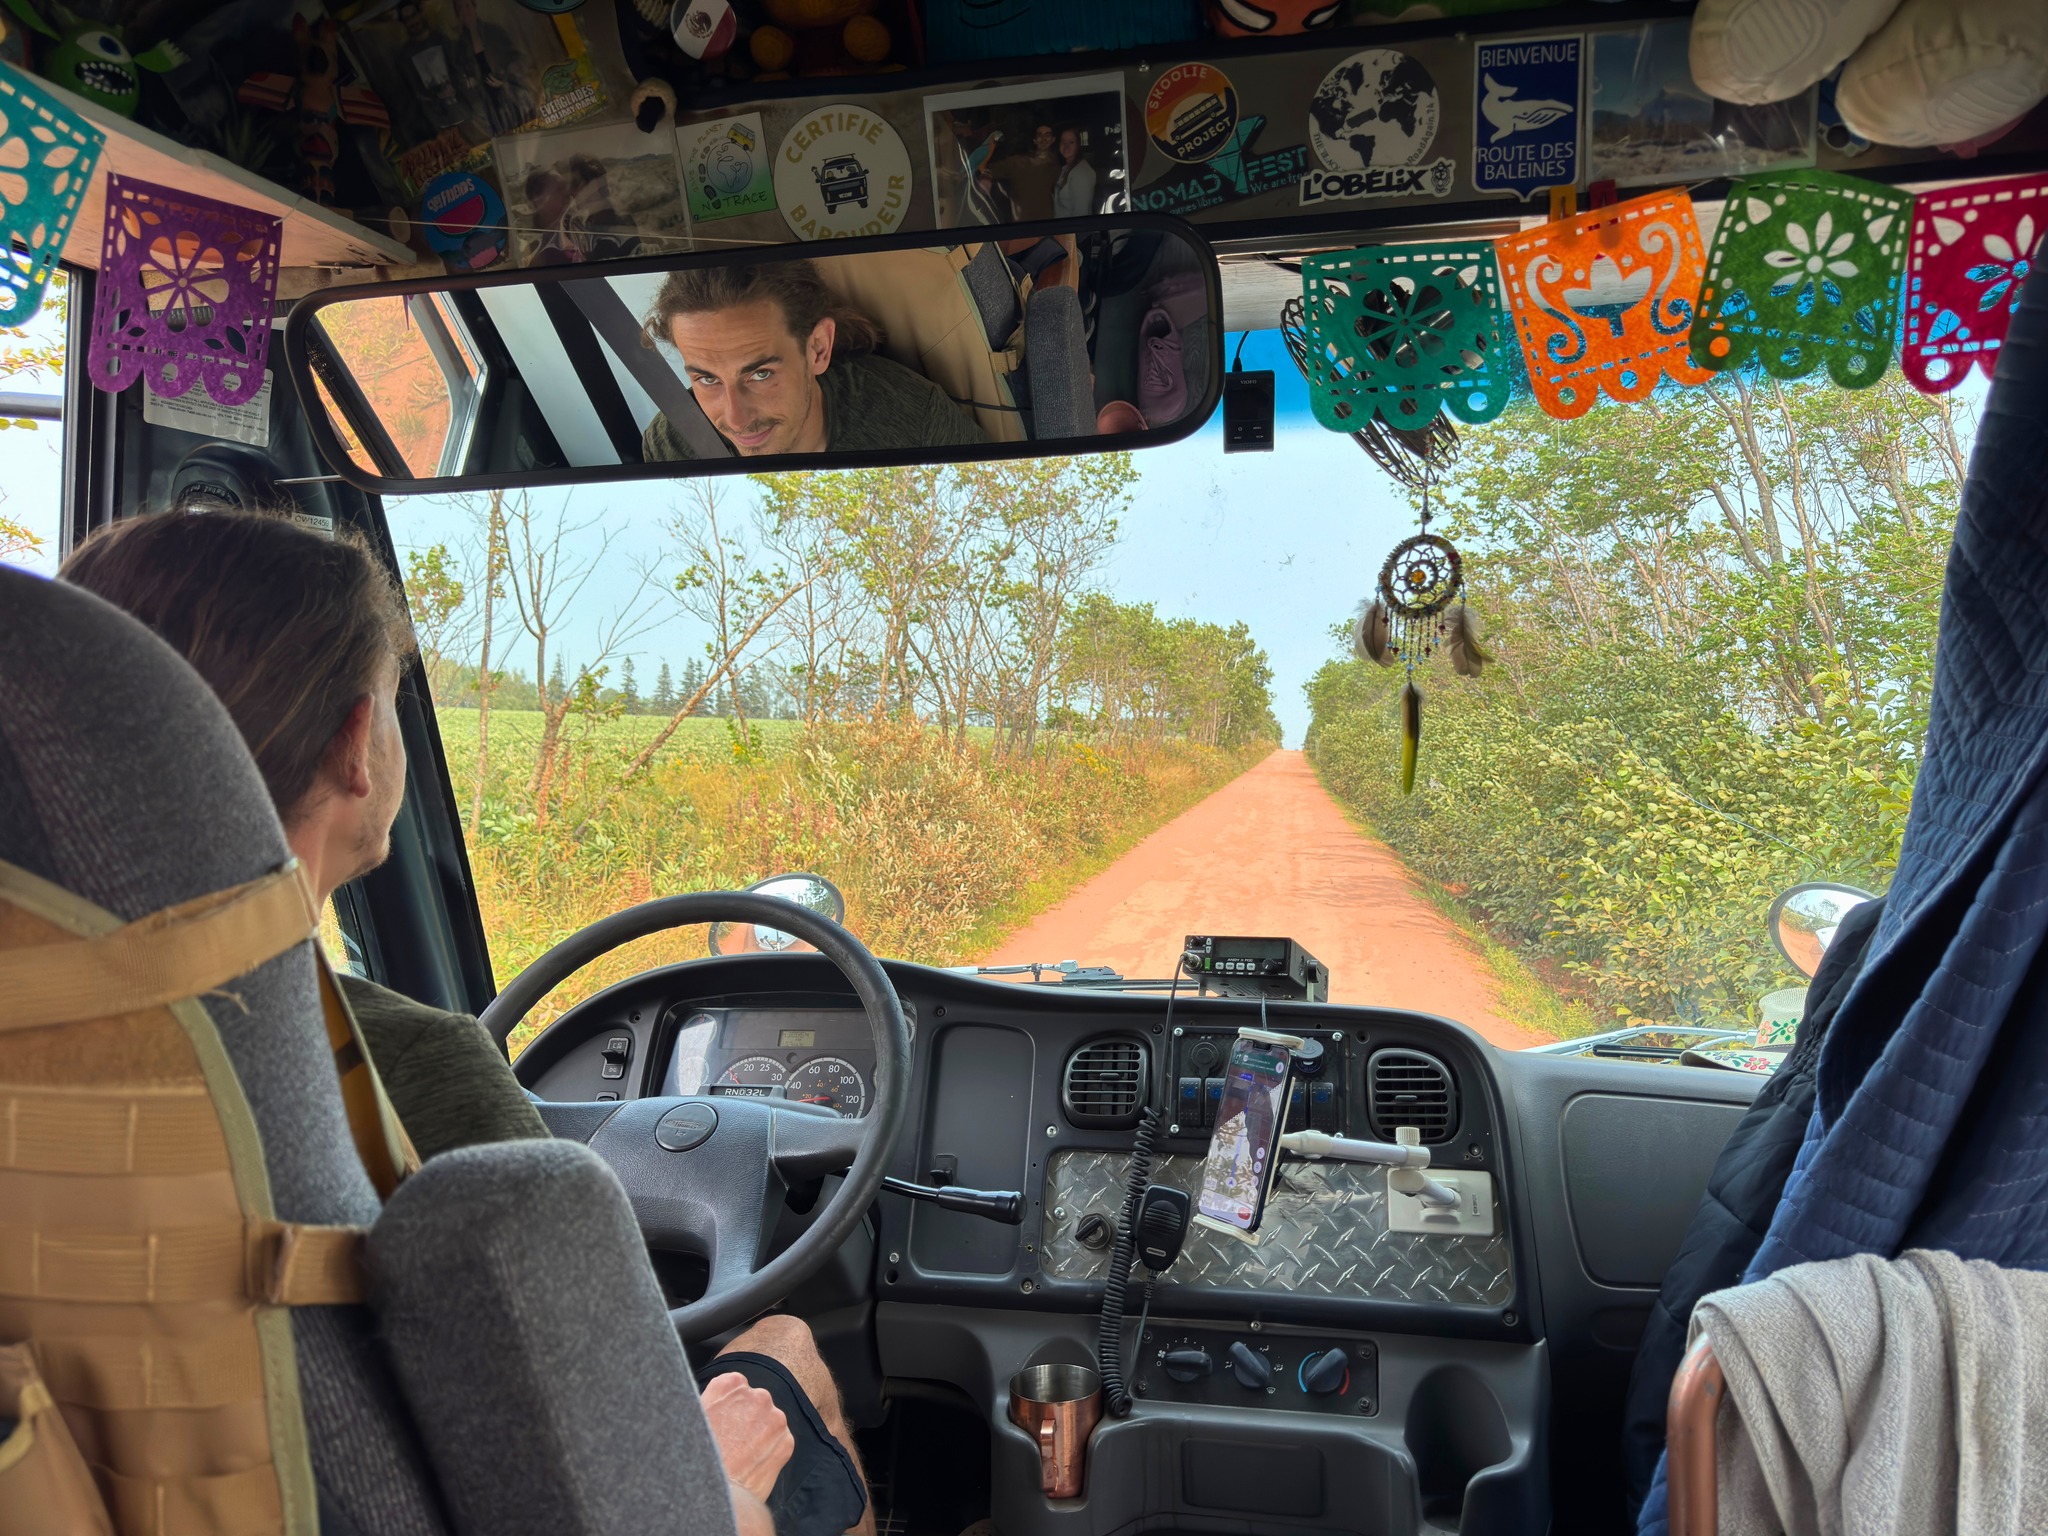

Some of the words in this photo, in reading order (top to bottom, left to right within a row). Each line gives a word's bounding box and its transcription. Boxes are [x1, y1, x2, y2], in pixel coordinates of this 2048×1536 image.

[1481, 43, 1577, 68] BIENVENUE
[1150, 65, 1207, 110] SKOOLIE
[539, 84, 595, 117] EVERGLADES
[785, 112, 884, 164] CERTIFIÉ
[1177, 117, 1232, 157] PROJECT
[1314, 133, 1324, 150] THE
[1477, 145, 1536, 163] ROUTE
[1541, 141, 1574, 160] DES
[1246, 146, 1307, 181] FEST
[1484, 160, 1566, 181] BALEINES
[1250, 181, 1269, 194] We
[1271, 178, 1287, 188] are
[722, 190, 767, 207] TRACE
[1197, 195, 1223, 208] libres
[743, 1063, 754, 1072] 20
[759, 1063, 770, 1072] 25
[808, 1065, 821, 1074] 60
[828, 1064, 840, 1073] 80
[771, 1073, 782, 1081] 30
[790, 1081, 802, 1090] 40
[840, 1076, 855, 1085] 100
[845, 1095, 859, 1104] 120
